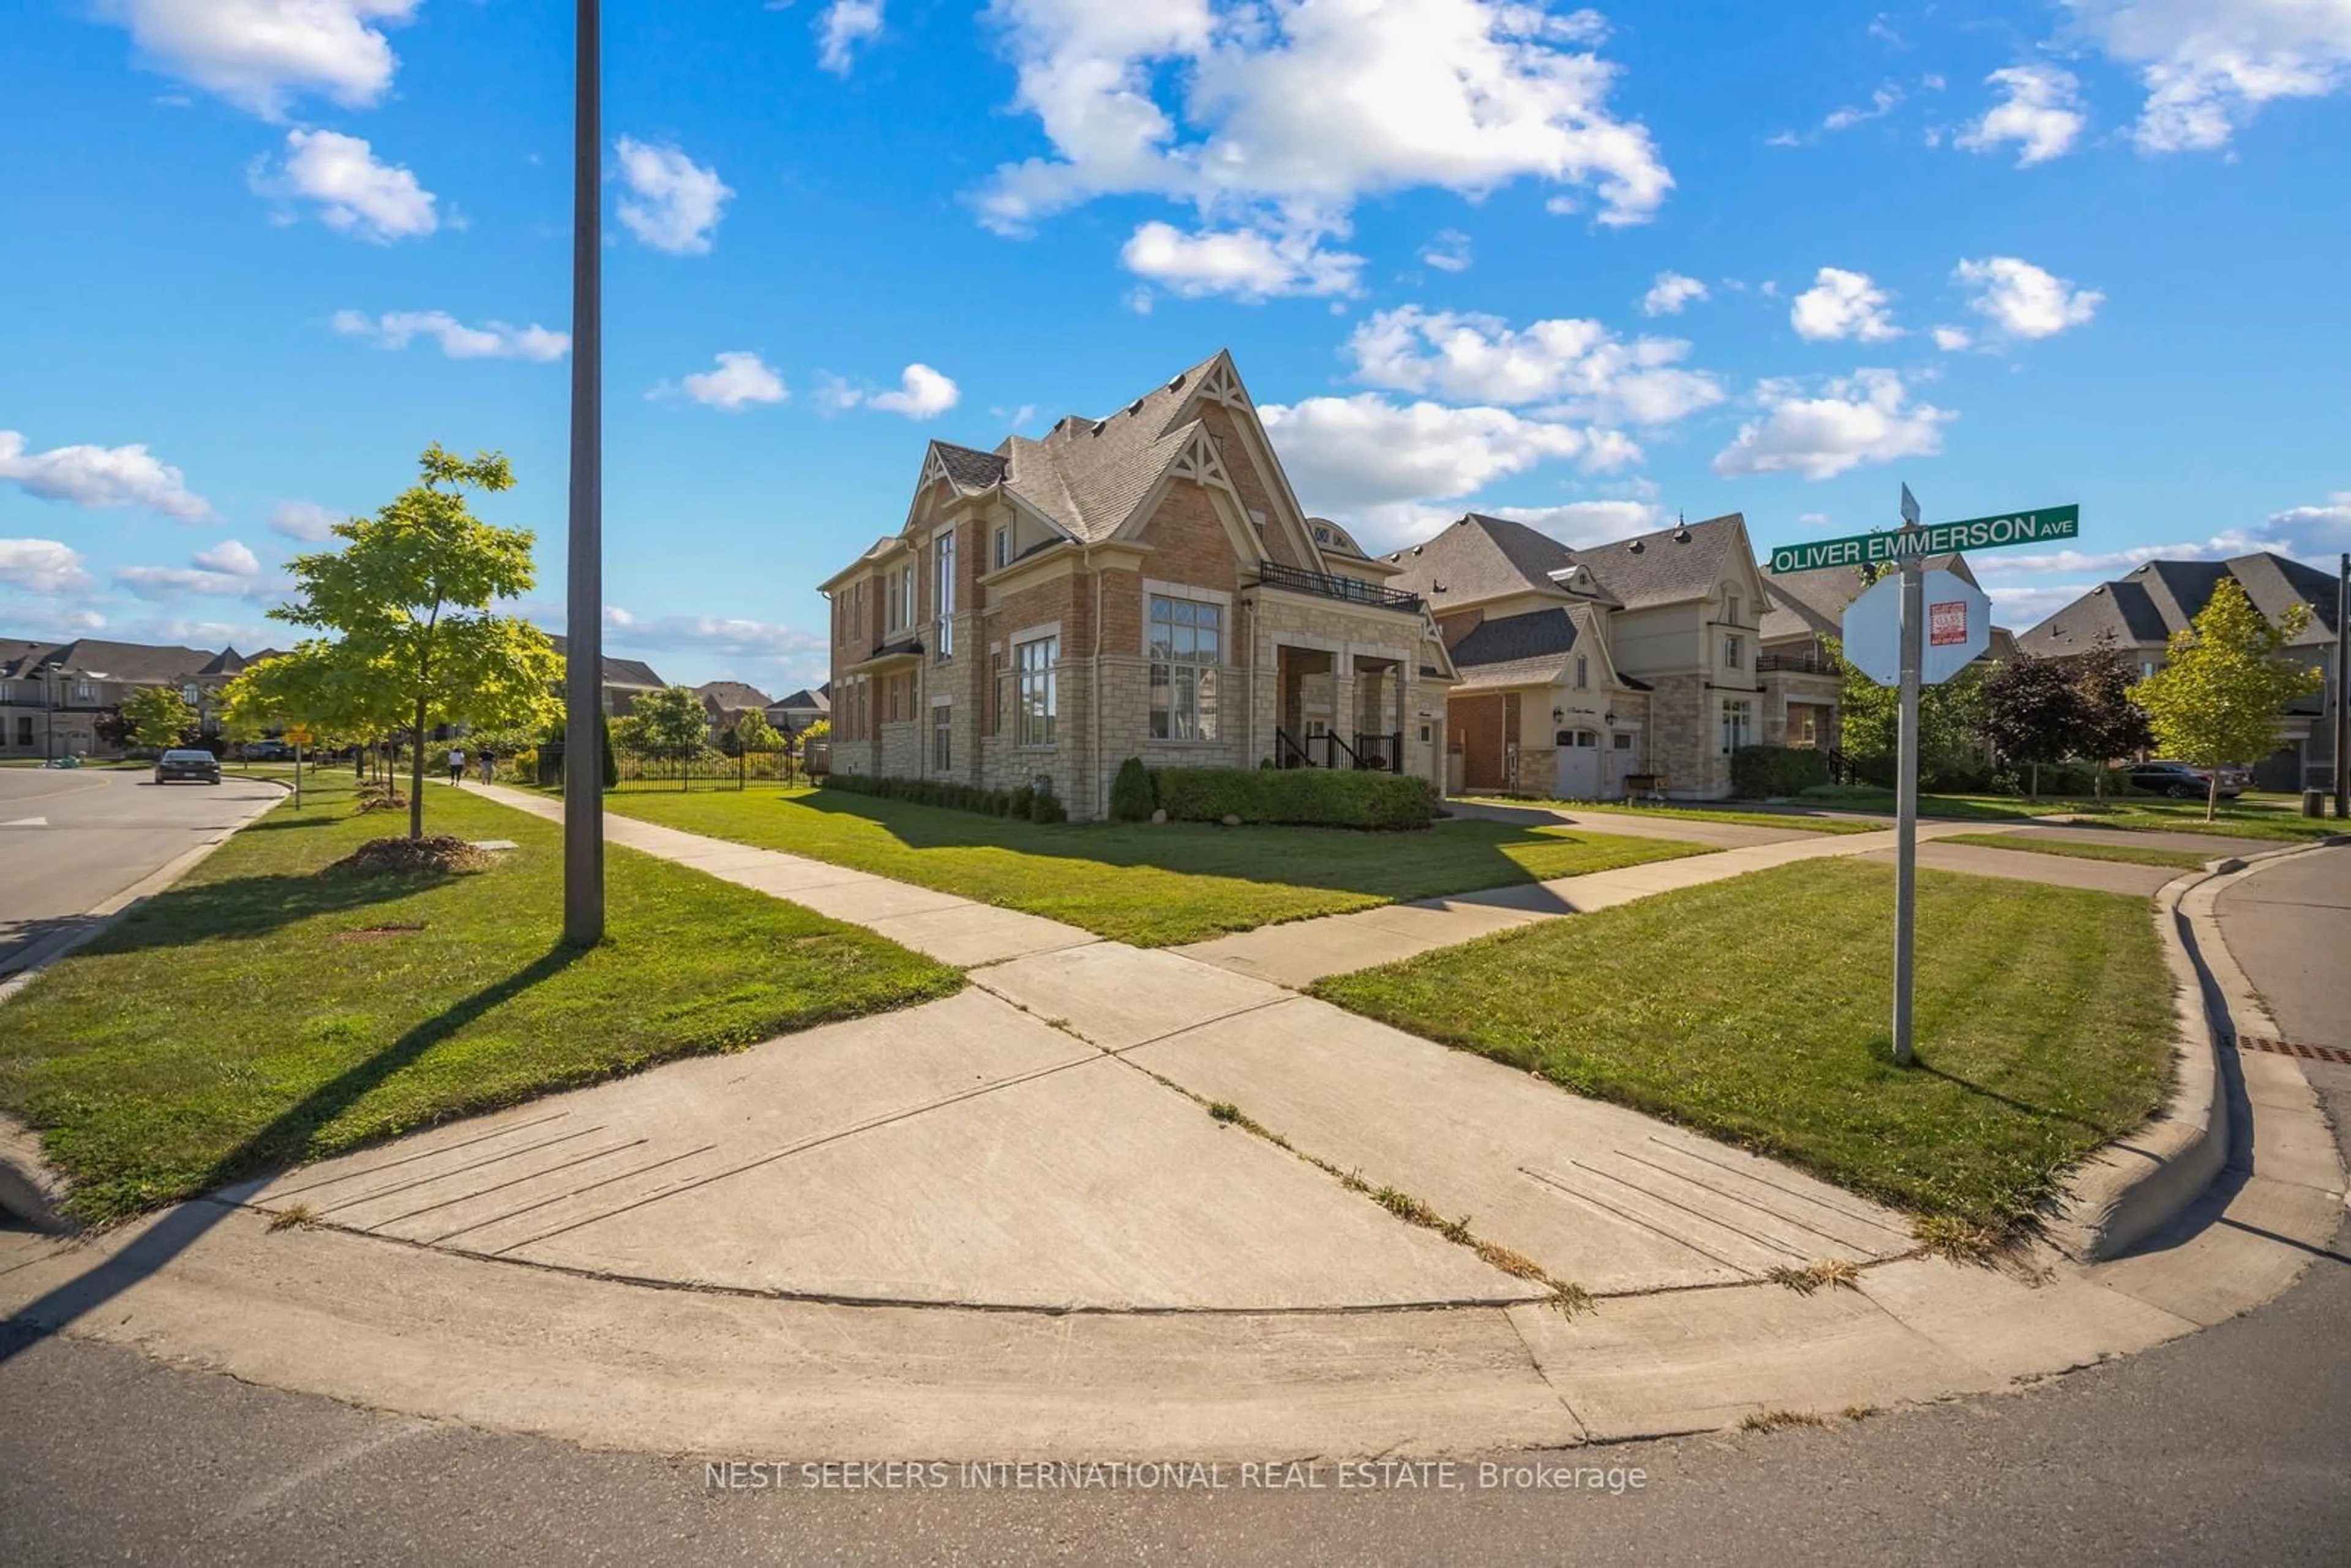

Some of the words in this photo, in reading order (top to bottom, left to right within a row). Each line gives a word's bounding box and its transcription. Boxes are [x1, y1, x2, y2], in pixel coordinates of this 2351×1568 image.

[1775, 541, 1860, 572] OLIVER
[1868, 516, 2036, 559] EMMERSON
[2041, 520, 2073, 536] AVE
